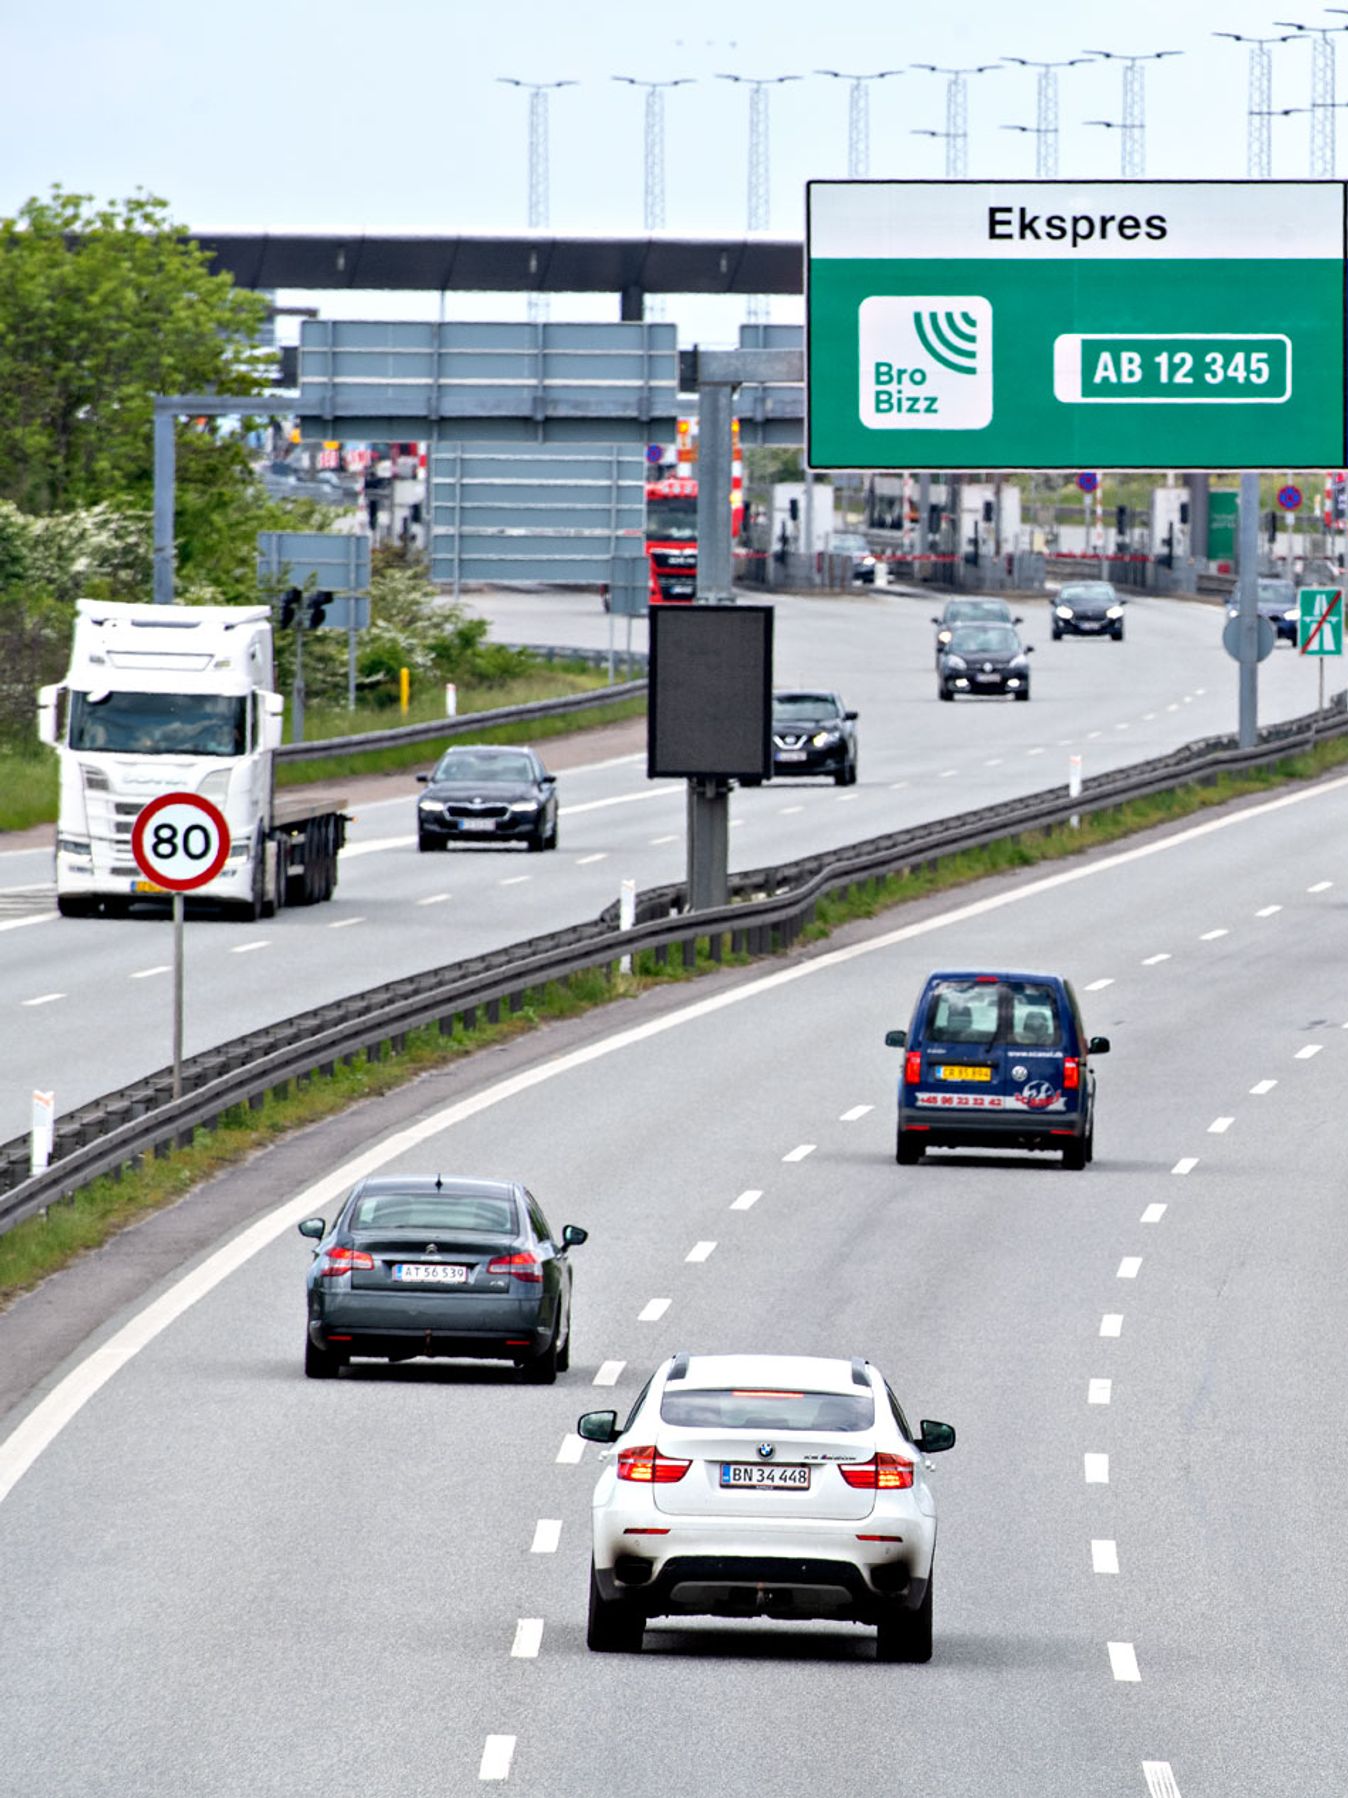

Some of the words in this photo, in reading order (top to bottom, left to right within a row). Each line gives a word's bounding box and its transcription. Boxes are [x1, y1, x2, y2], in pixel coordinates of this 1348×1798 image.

[988, 206, 1168, 248] Ekspres
[874, 362, 927, 385] Bro
[1093, 352, 1143, 384] AB
[1155, 352, 1194, 384] 12
[1204, 352, 1270, 384] 345
[874, 390, 939, 413] Bizz
[152, 823, 211, 860] 80
[405, 1267, 420, 1277] AT
[424, 1267, 439, 1277] 56
[441, 1268, 464, 1279] 539
[732, 1467, 754, 1482] BN
[756, 1468, 775, 1483] 34
[779, 1470, 807, 1484] 448
